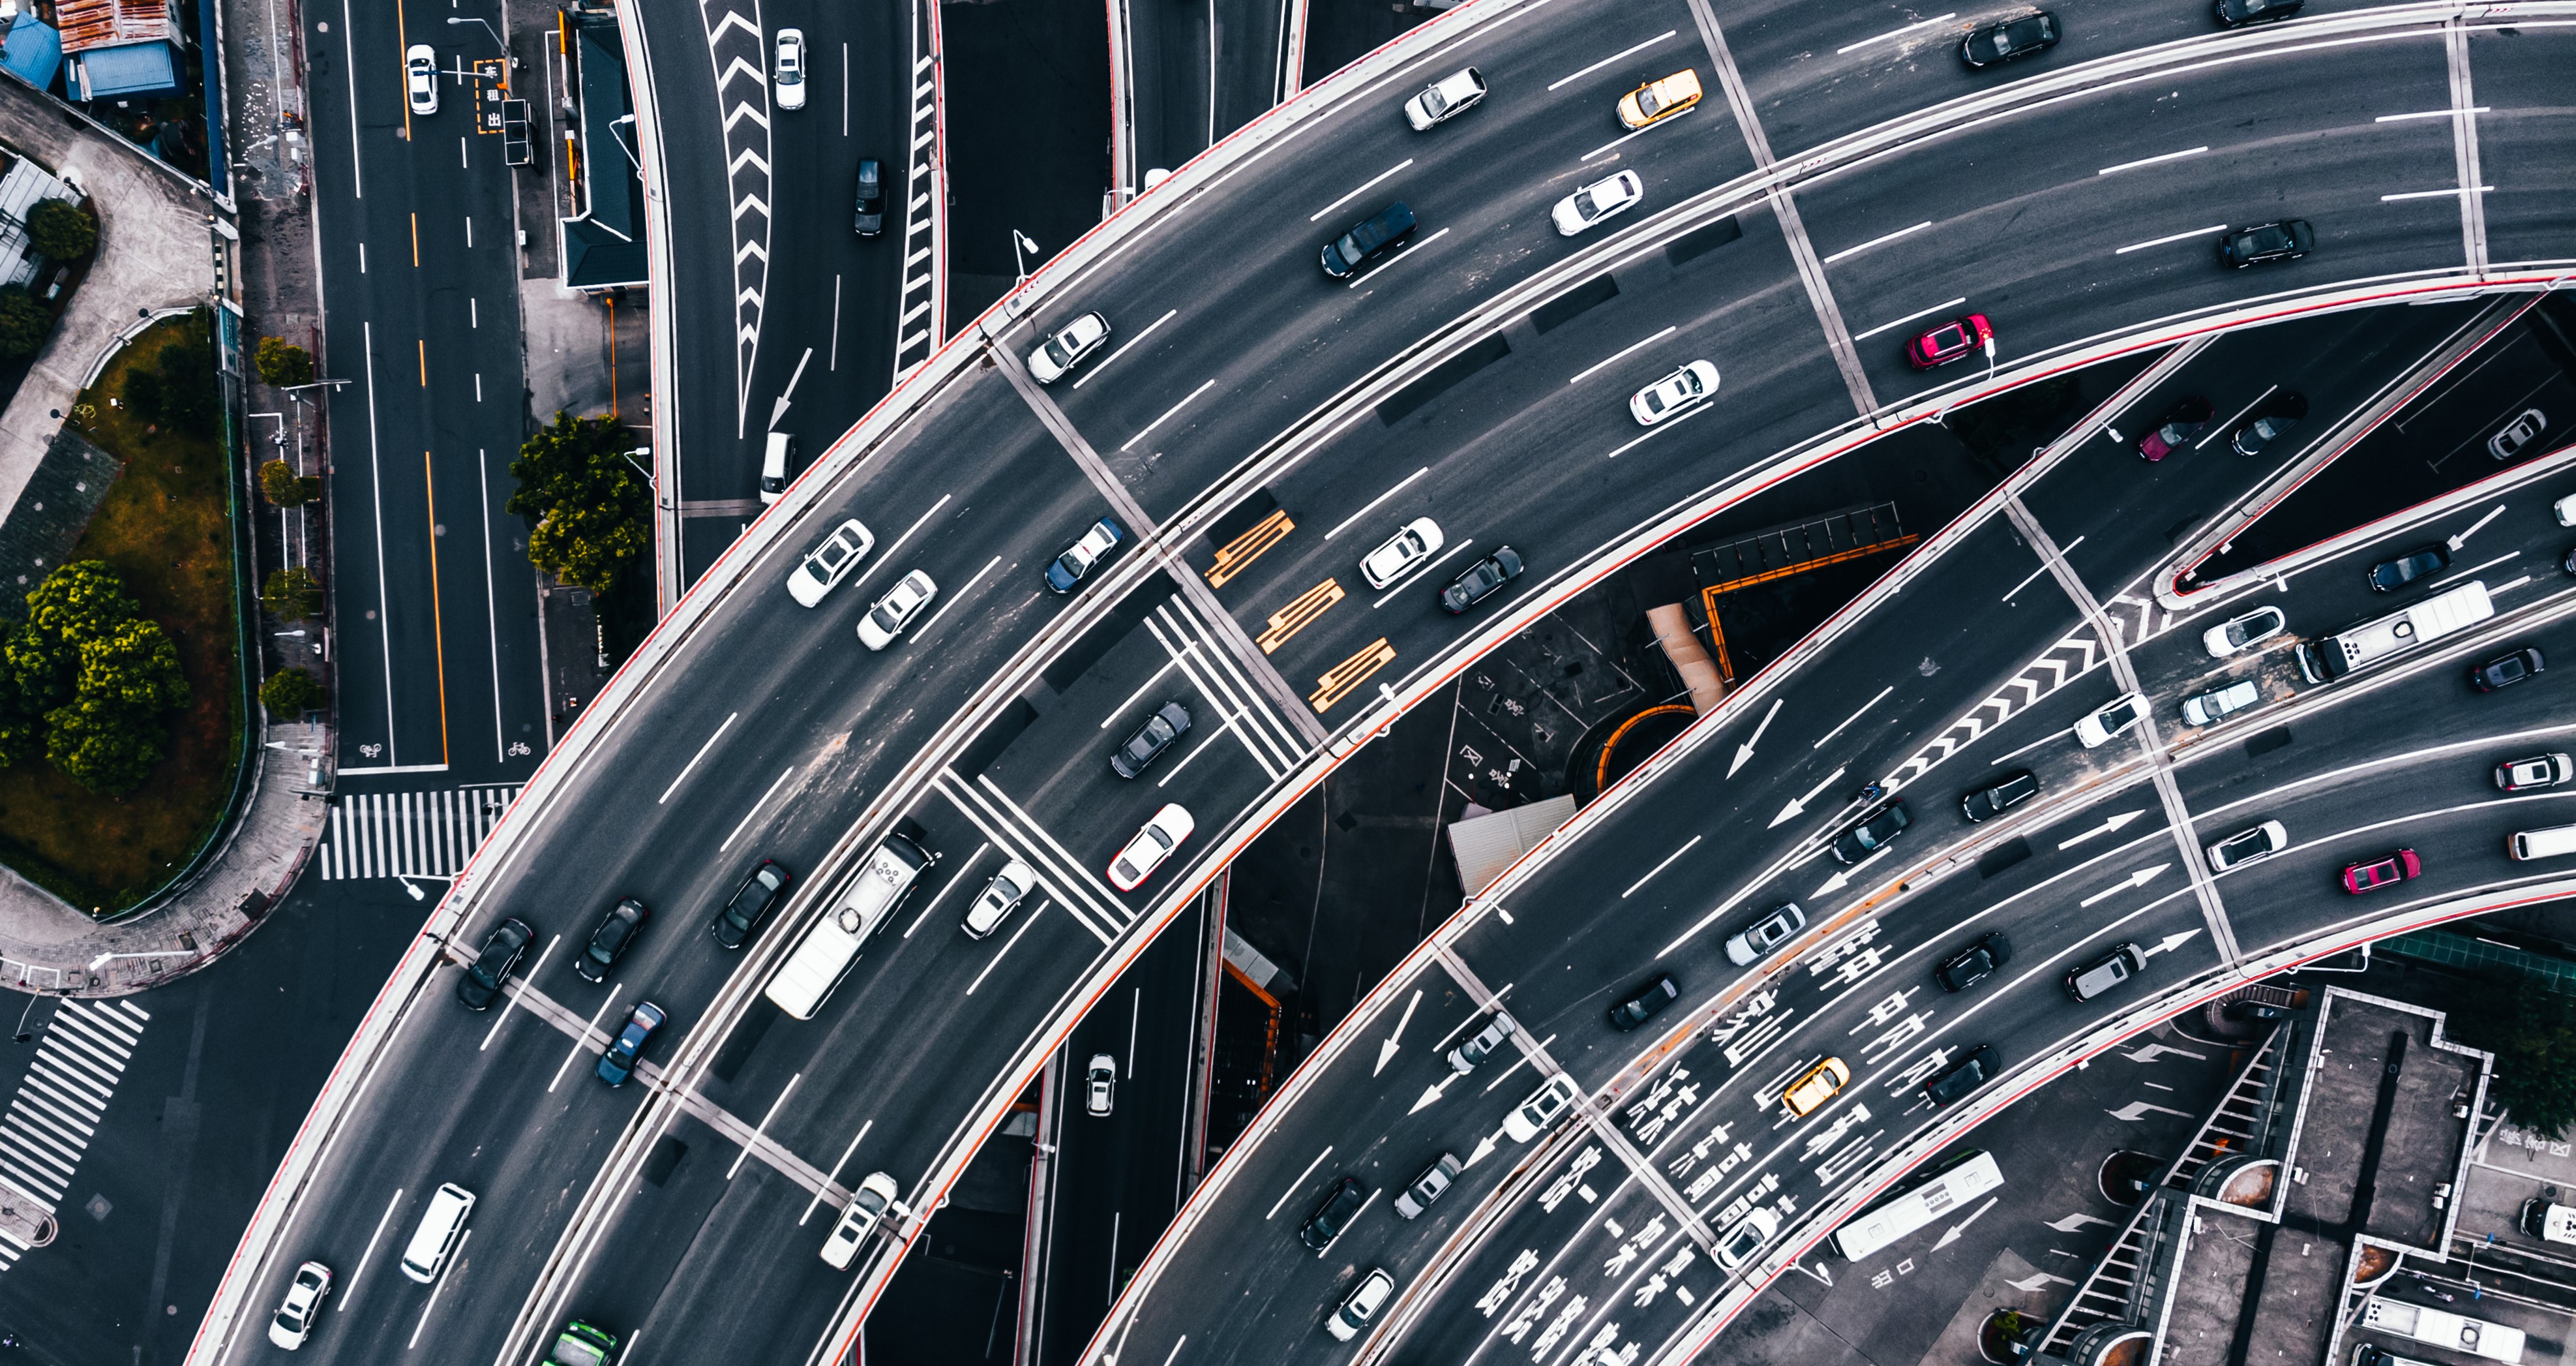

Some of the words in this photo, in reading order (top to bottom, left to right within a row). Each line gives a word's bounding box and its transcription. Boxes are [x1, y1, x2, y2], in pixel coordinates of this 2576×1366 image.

[1204, 509, 1296, 589] 40
[1255, 577, 1345, 655] 40
[1308, 637, 1396, 714] 40
[1871, 1258, 1915, 1289] 出口
